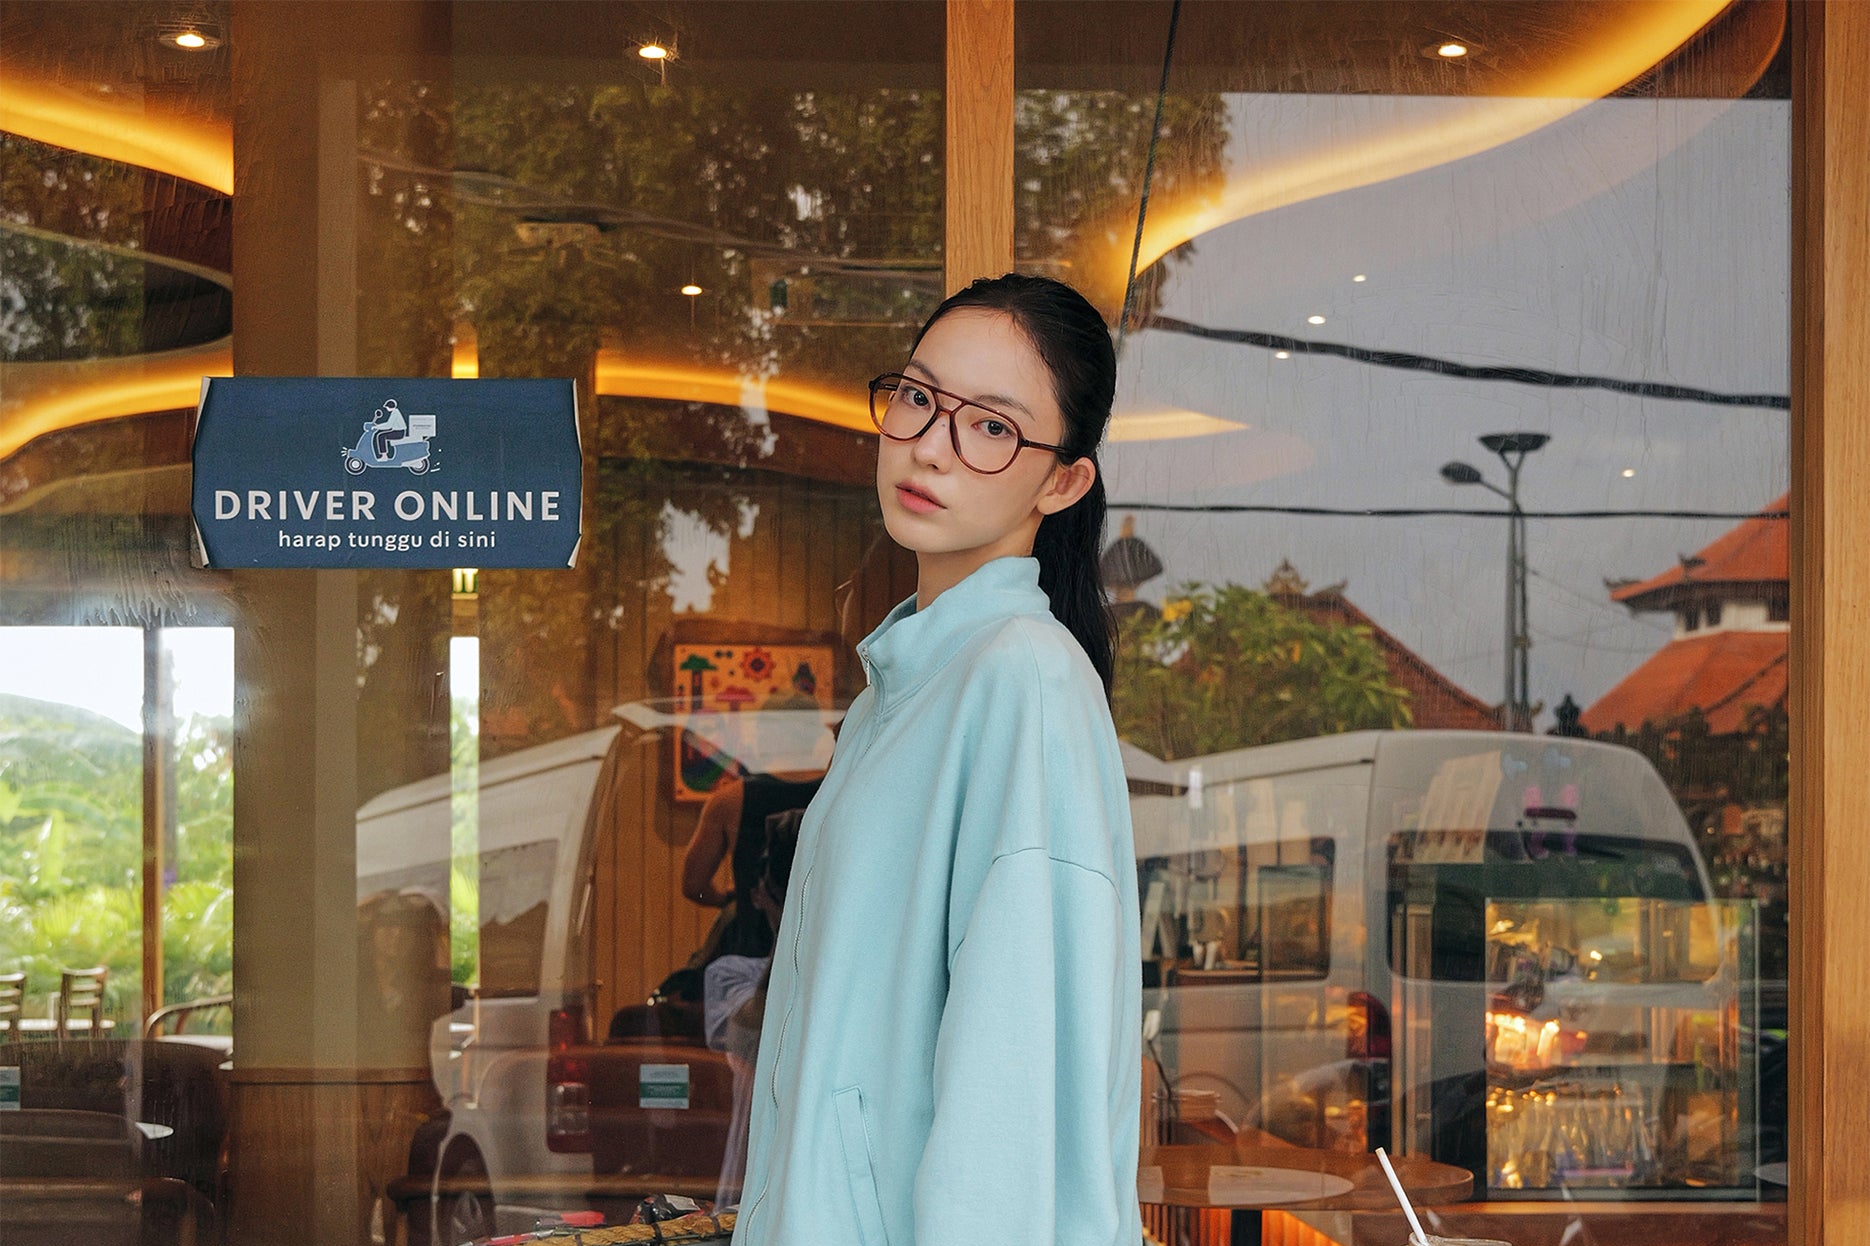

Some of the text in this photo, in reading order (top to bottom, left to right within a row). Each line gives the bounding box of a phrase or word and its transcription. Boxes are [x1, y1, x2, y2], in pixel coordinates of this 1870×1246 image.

[215, 490, 560, 521] DRIVER ONLINE
[278, 530, 495, 552] harap tunggu di sini
